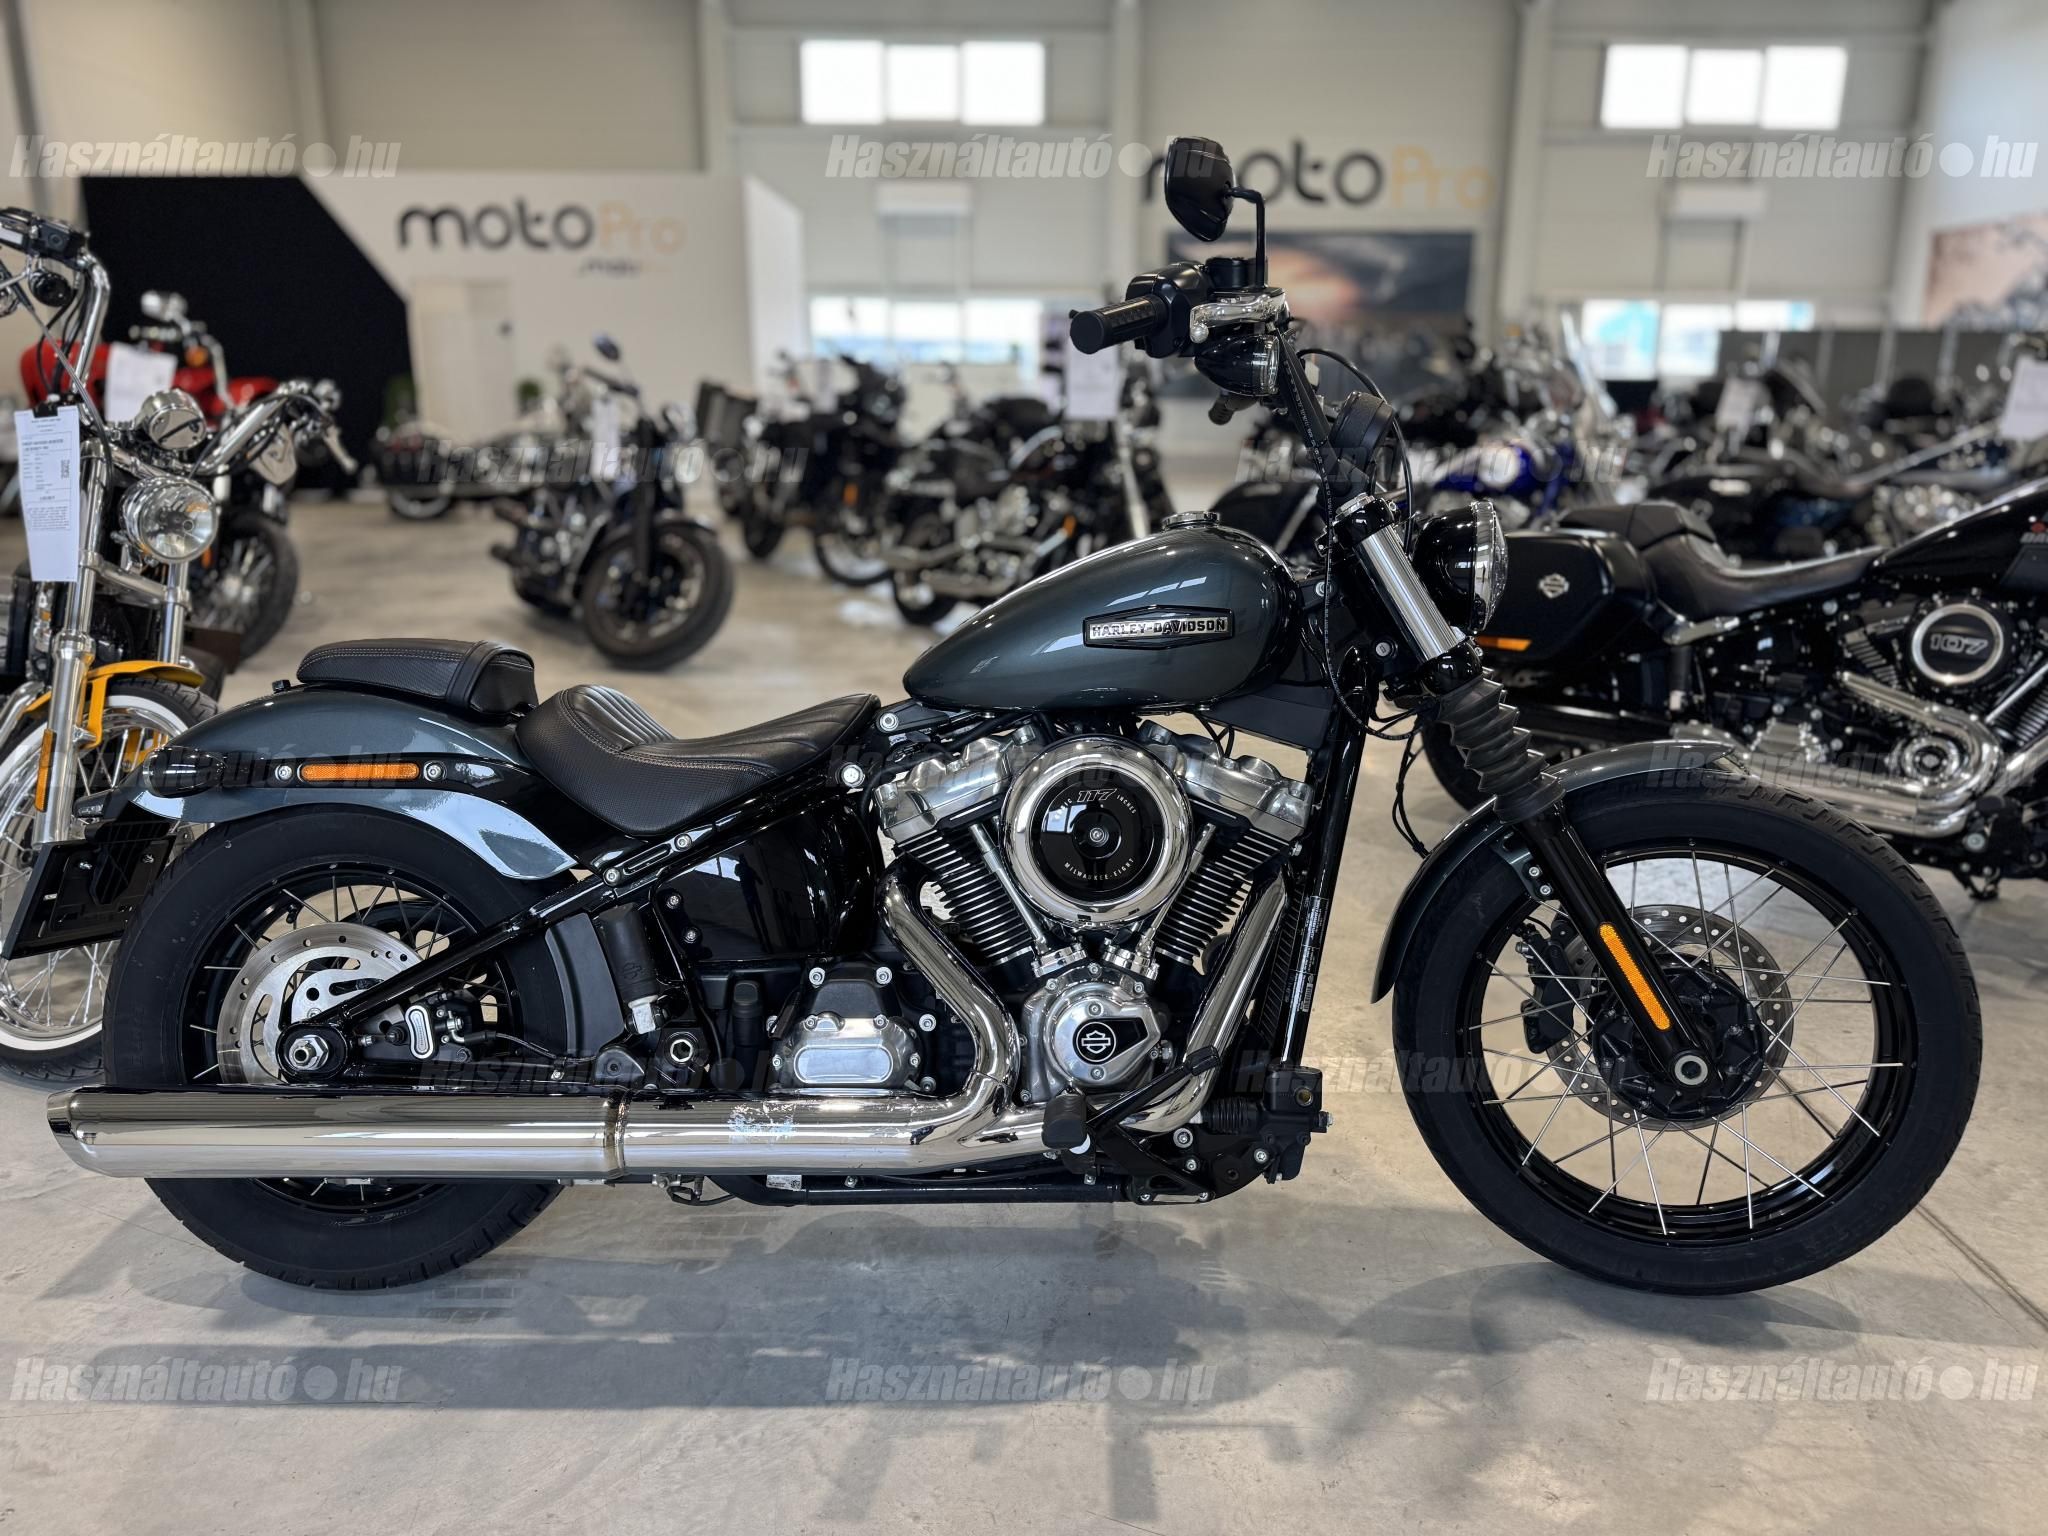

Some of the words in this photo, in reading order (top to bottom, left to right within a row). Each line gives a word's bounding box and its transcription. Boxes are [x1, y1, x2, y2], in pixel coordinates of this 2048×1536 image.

[1091, 618, 1226, 638] HARLEY-DAVIDSON
[1930, 634, 1988, 654] 107
[1077, 788, 1118, 803] 117
[1116, 794, 1137, 815] INCHES
[1064, 858, 1135, 881] MILWAUKEE-EIGHT
